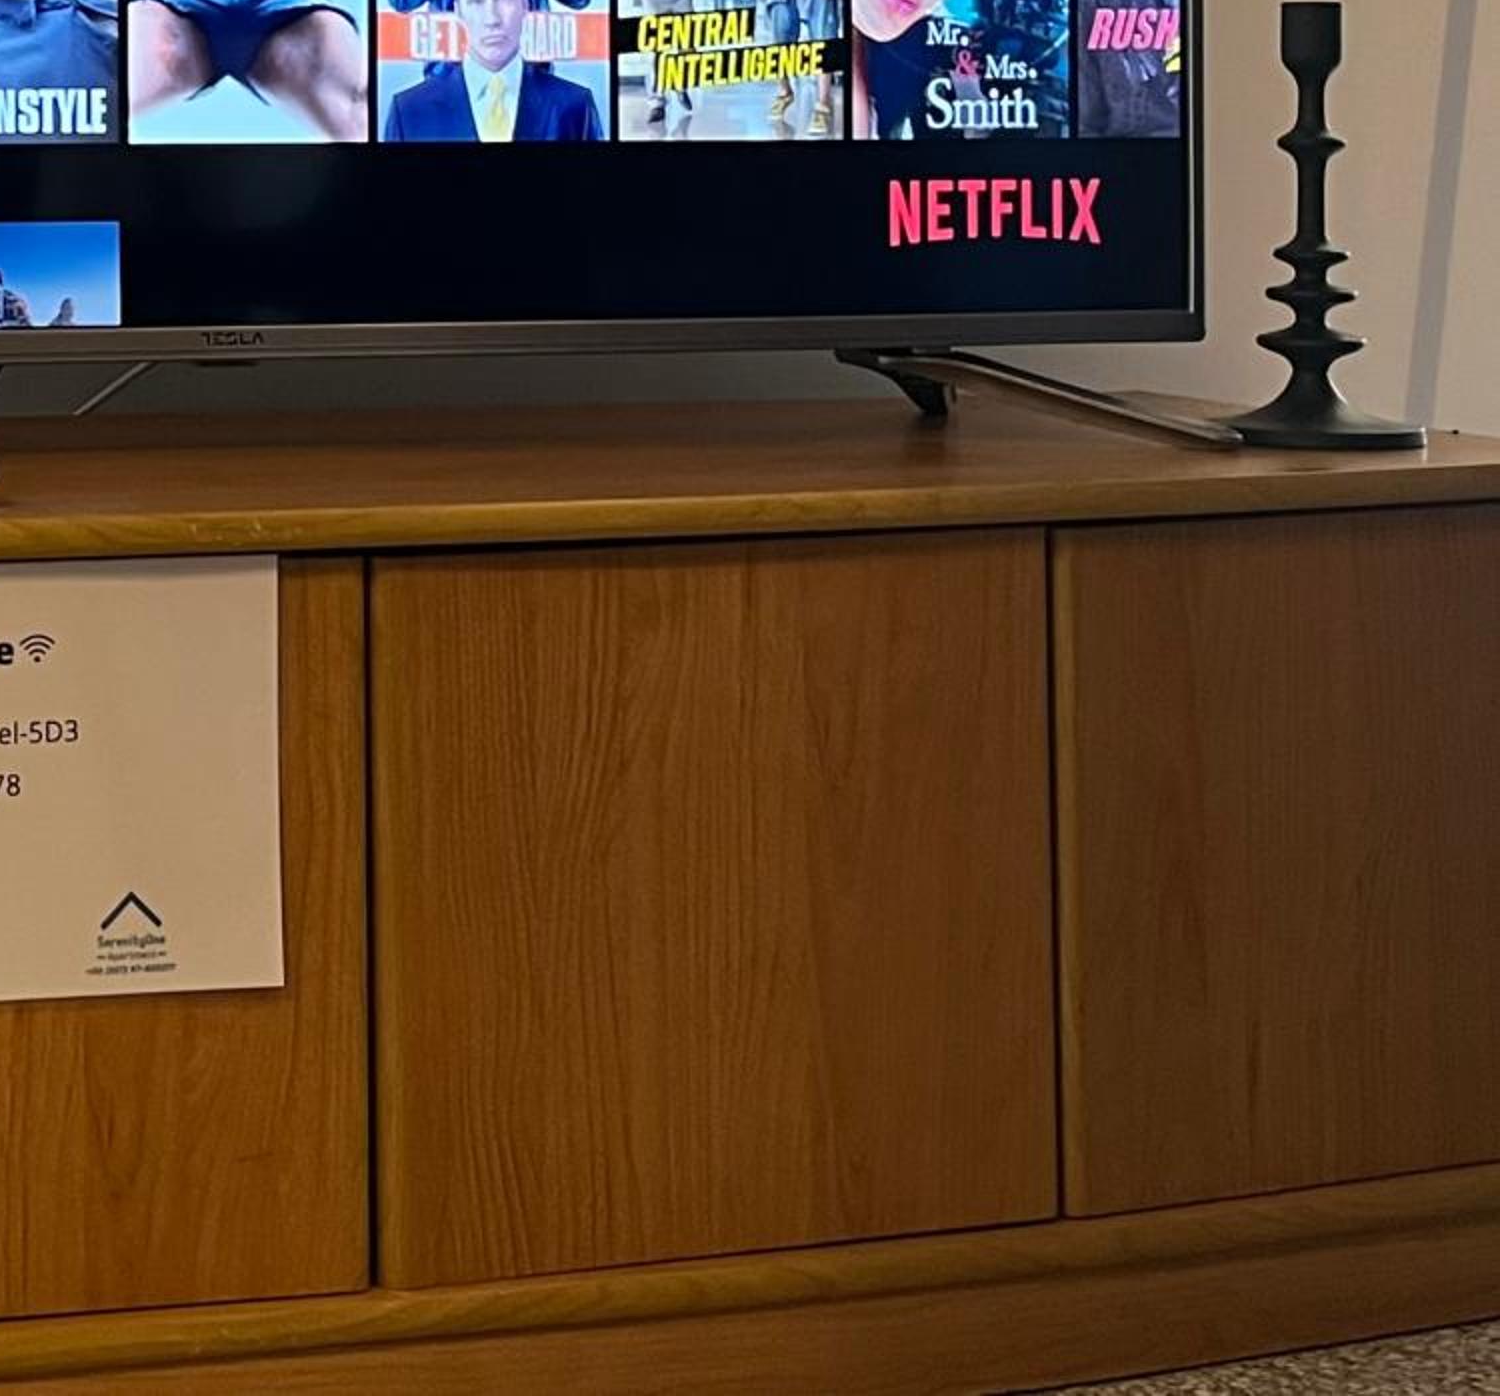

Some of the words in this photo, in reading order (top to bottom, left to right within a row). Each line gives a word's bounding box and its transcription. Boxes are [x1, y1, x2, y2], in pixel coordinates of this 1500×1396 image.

[410, 13, 466, 60] GET
[638, 10, 754, 53] CENTRAL
[926, 19, 969, 46] Mr.
[1087, 9, 1180, 50] RUSH
[657, 42, 826, 93] INTELLIGENCE
[984, 54, 1037, 79] Mrs.
[926, 77, 1039, 129] Smith
[889, 178, 1101, 247] NETFLIX
[201, 332, 265, 346] TESLA
